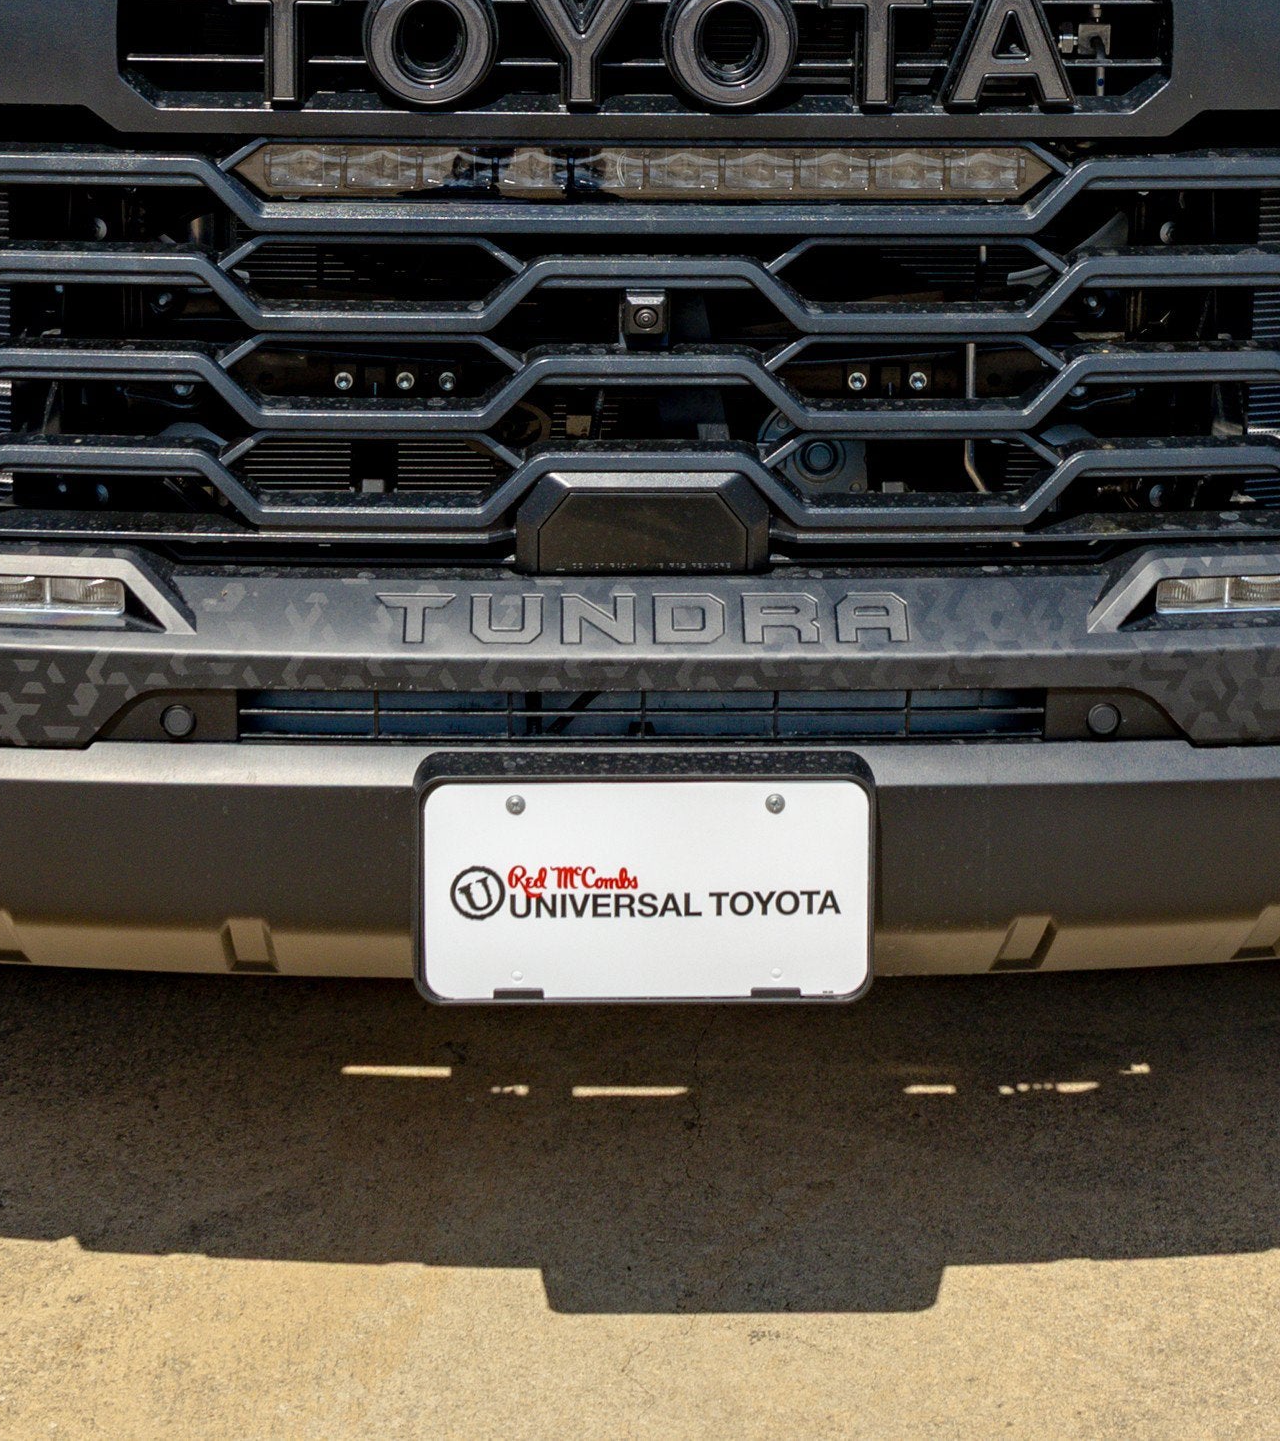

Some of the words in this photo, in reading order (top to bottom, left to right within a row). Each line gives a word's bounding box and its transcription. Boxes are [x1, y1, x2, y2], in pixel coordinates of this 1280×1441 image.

[376, 591, 910, 645] TUNDRA
[508, 865, 548, 899] Red
[550, 866, 638, 890] McCombs
[509, 892, 702, 919] UNIVERSAL
[709, 890, 842, 916] TOYOTA
